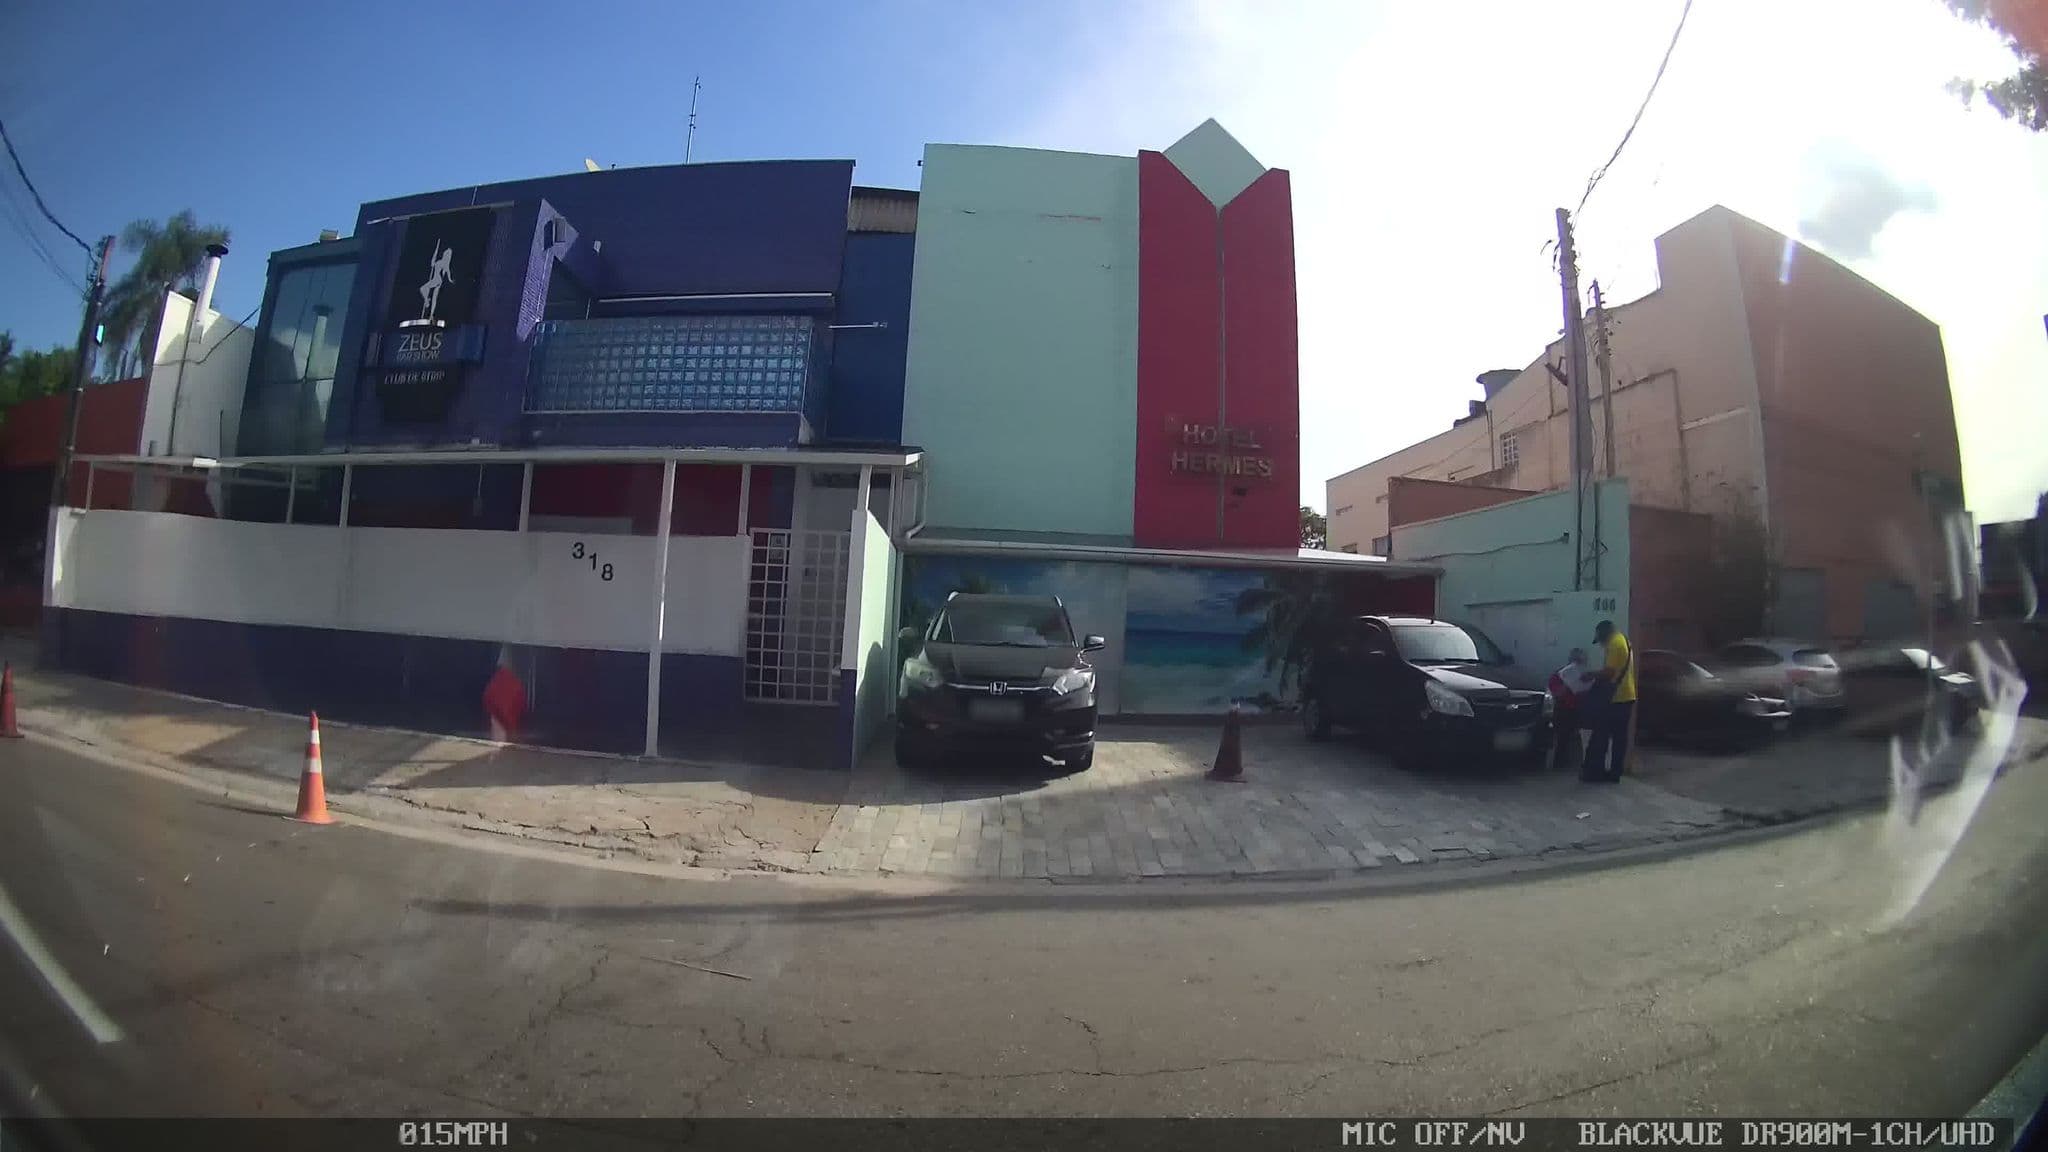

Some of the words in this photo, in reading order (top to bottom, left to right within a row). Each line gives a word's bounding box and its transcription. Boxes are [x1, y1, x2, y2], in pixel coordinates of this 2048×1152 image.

[398, 332, 443, 352] ZEUS
[1183, 423, 1262, 449] HOTEL
[1170, 451, 1272, 477] HERMES
[572, 542, 614, 581] 318
